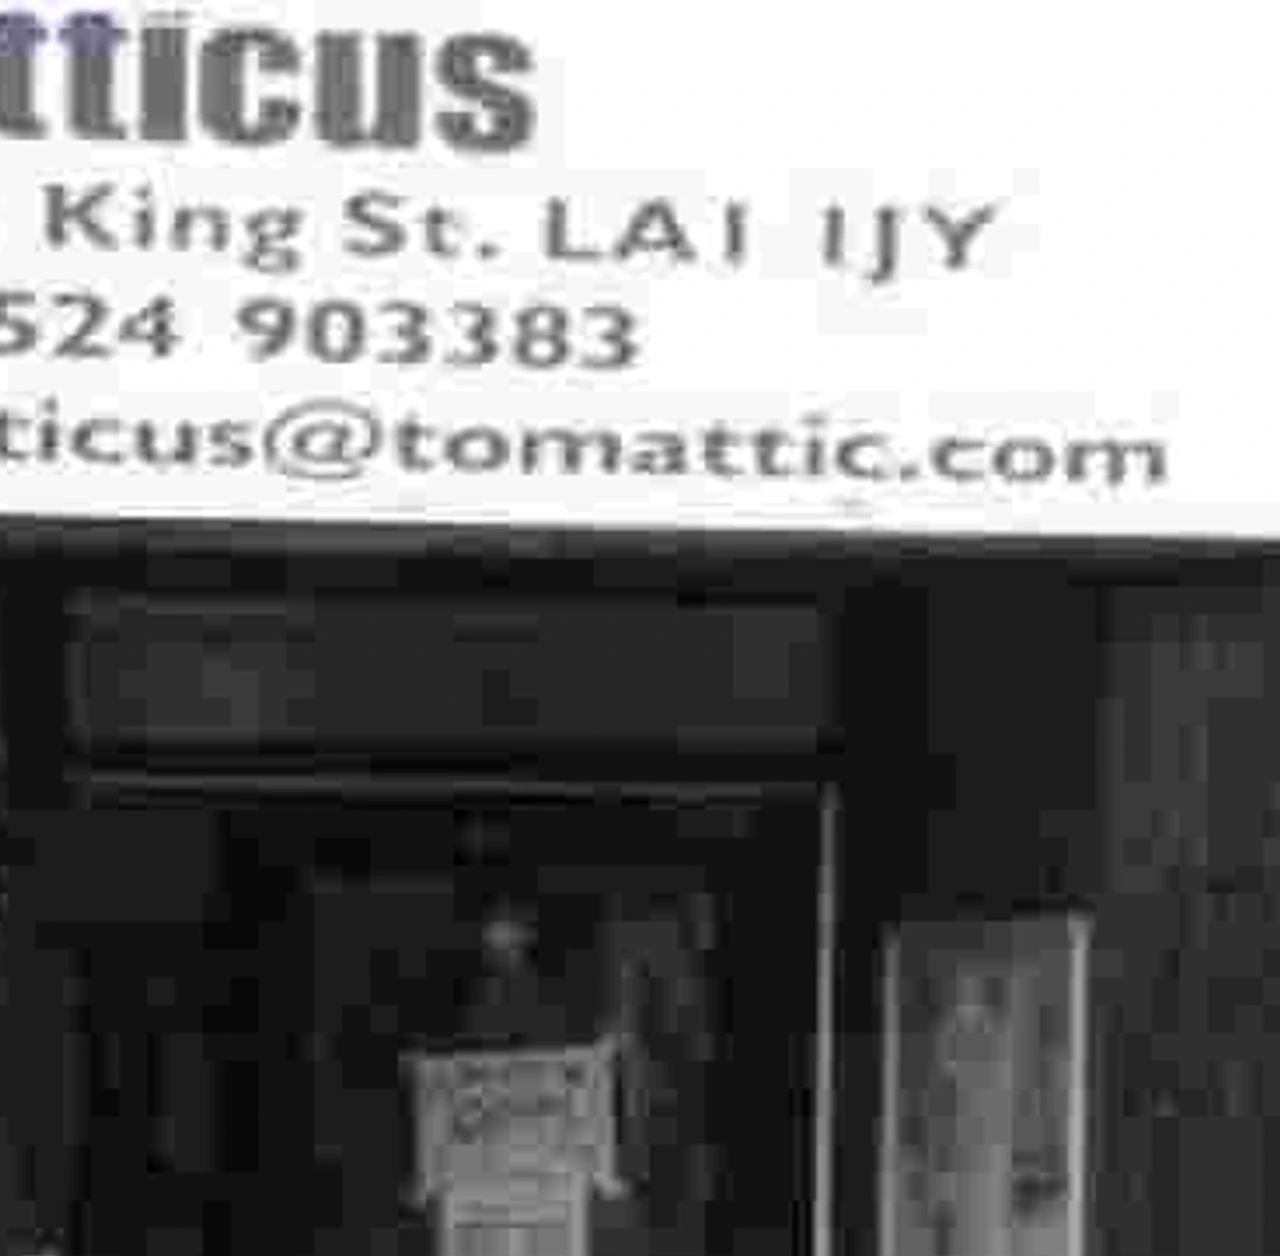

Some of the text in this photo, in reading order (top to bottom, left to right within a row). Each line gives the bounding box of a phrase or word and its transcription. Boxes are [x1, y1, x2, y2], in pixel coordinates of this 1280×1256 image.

[45, 184, 300, 273] King
[344, 191, 500, 259] St.
[236, 299, 638, 370] 903383
